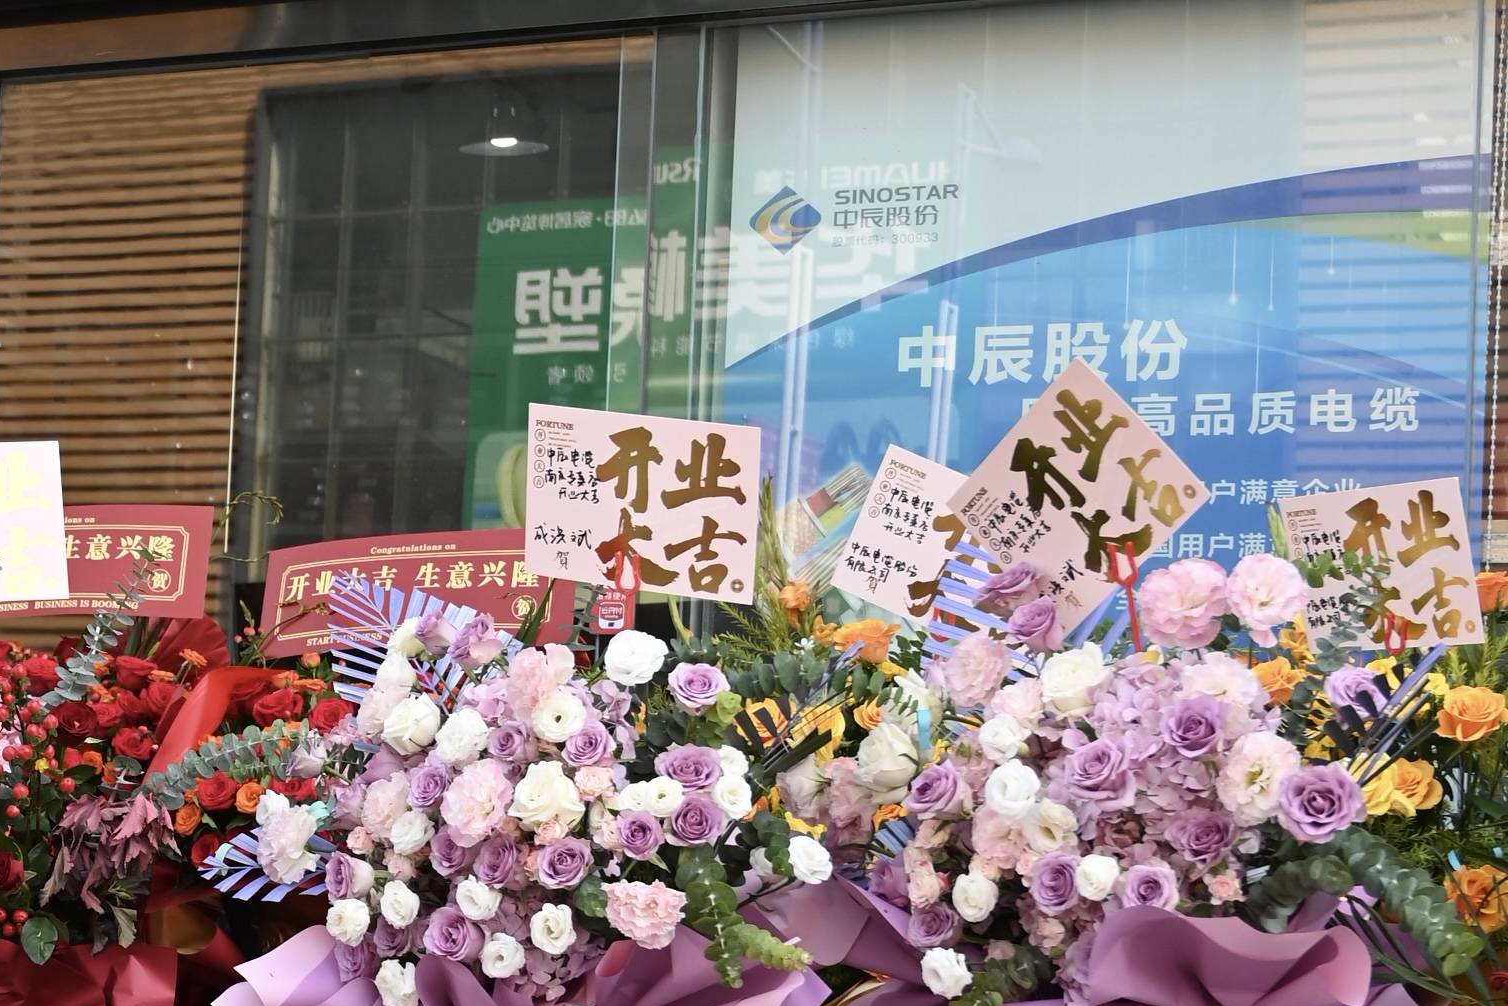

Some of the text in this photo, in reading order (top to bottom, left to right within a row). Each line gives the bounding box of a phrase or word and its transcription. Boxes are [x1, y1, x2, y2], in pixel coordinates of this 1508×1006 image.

[834, 184, 959, 206] SINOSTAR
[833, 204, 939, 229] 中辰股份
[897, 319, 1189, 388] 中辰股份
[535, 419, 574, 431] FORTUNE
[595, 425, 748, 514] 开业
[889, 459, 927, 480] FORTUNE
[1286, 508, 1317, 518] FORTUNE
[1343, 489, 1461, 576] 开业
[64, 533, 176, 562] 生意兴隆
[370, 543, 457, 555] Congratulations on
[594, 507, 748, 595] 大吉
[414, 559, 540, 590] 生意兴隆
[34, 600, 78, 610] BUSINESS
[79, 599, 89, 609] IS
[91, 599, 139, 611] BOOMNG
[306, 636, 334, 647] START
